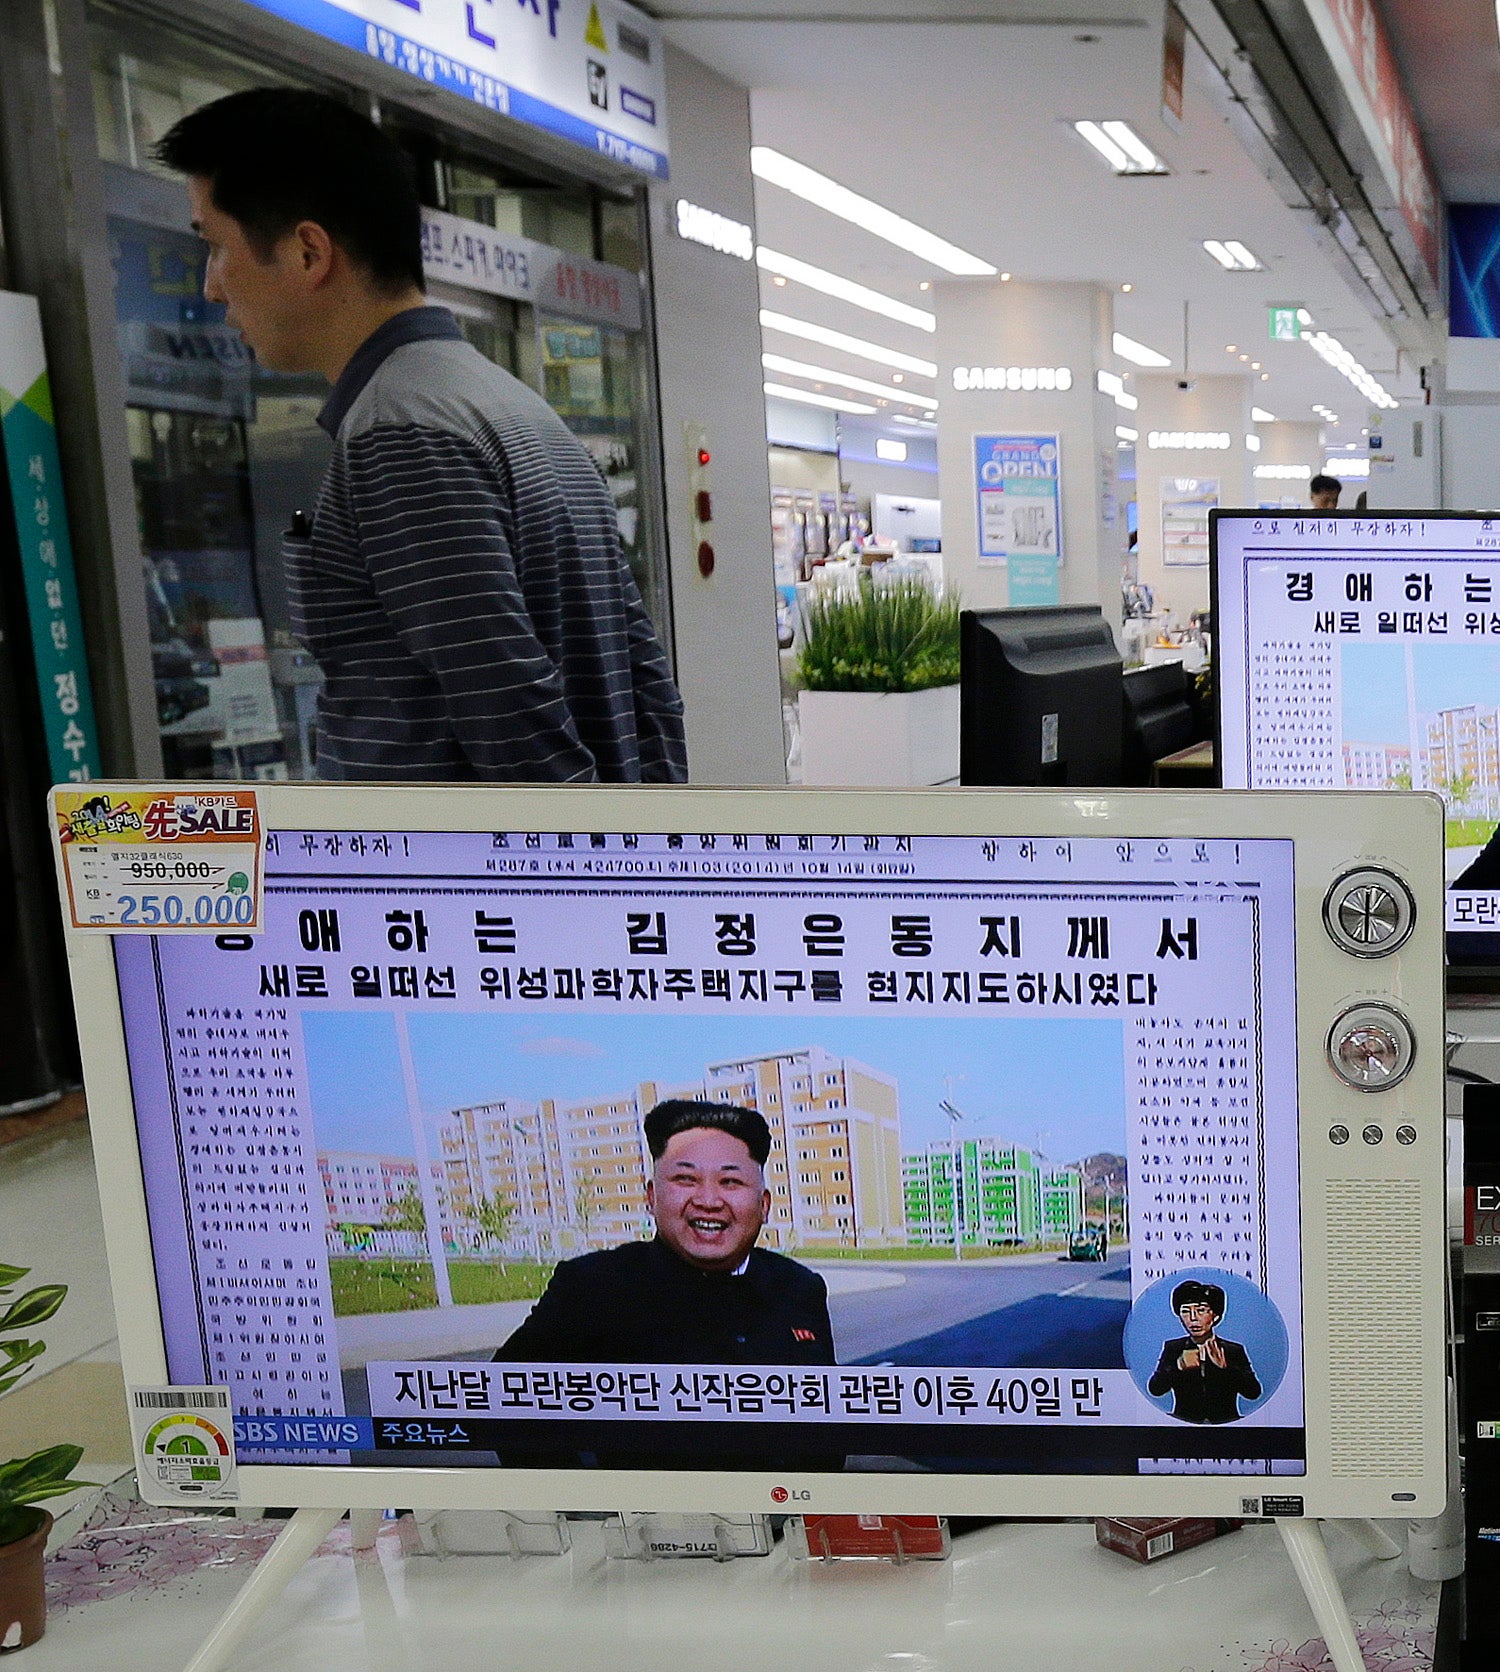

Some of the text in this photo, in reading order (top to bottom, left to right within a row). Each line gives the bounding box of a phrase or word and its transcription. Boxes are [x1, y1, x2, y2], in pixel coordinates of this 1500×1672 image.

[953, 366, 1072, 390] SAMSUNG
[1314, 612, 1362, 634] 새로
[1377, 612, 1451, 635] 일떠선
[180, 809, 252, 833] SALE
[131, 862, 211, 880] 950,000
[258, 965, 1159, 1007] 새로 일떠선 위성과학자주택지구를 현지지도하시였다
[395, 1369, 1104, 1418] 지난달 모란봉악단 신작음악회 관람 이후 40일 만
[234, 1420, 359, 1444] SBS NEWS
[382, 1423, 470, 1445] 주요뉴스
[792, 1489, 811, 1501] LG
